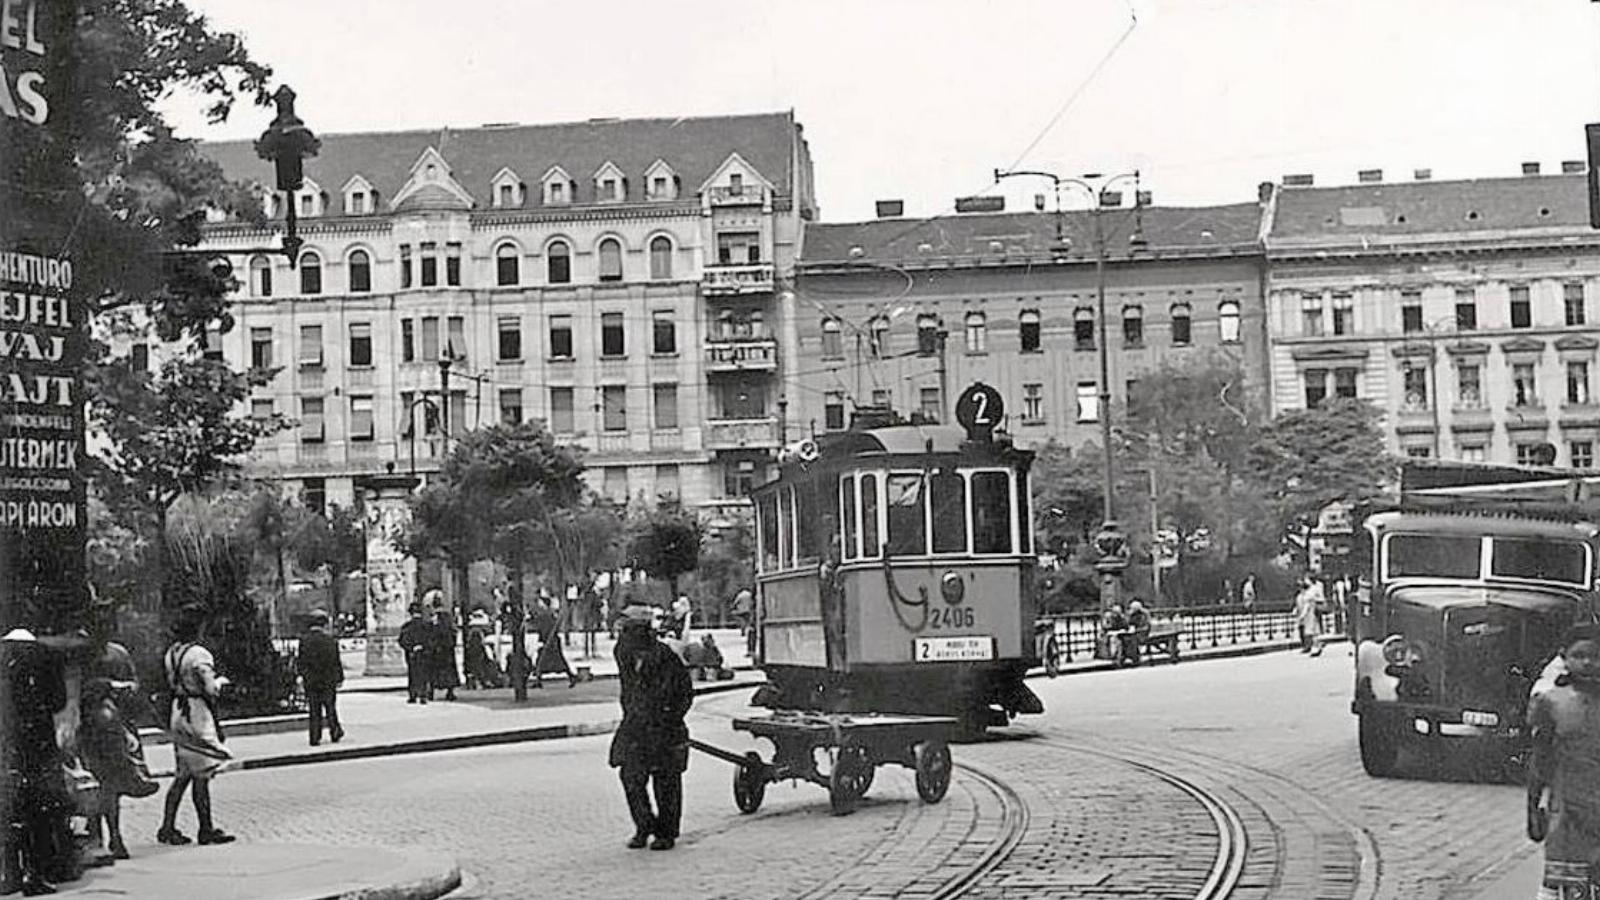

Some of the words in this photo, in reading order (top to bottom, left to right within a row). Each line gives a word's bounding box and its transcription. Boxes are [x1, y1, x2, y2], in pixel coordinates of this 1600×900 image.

[0, 291, 73, 328] EJFEL
[0, 331, 65, 361] VAJ
[0, 373, 75, 406] AJT
[972, 392, 991, 424] 2
[931, 607, 975, 629] 2406
[922, 643, 930, 659] 2
